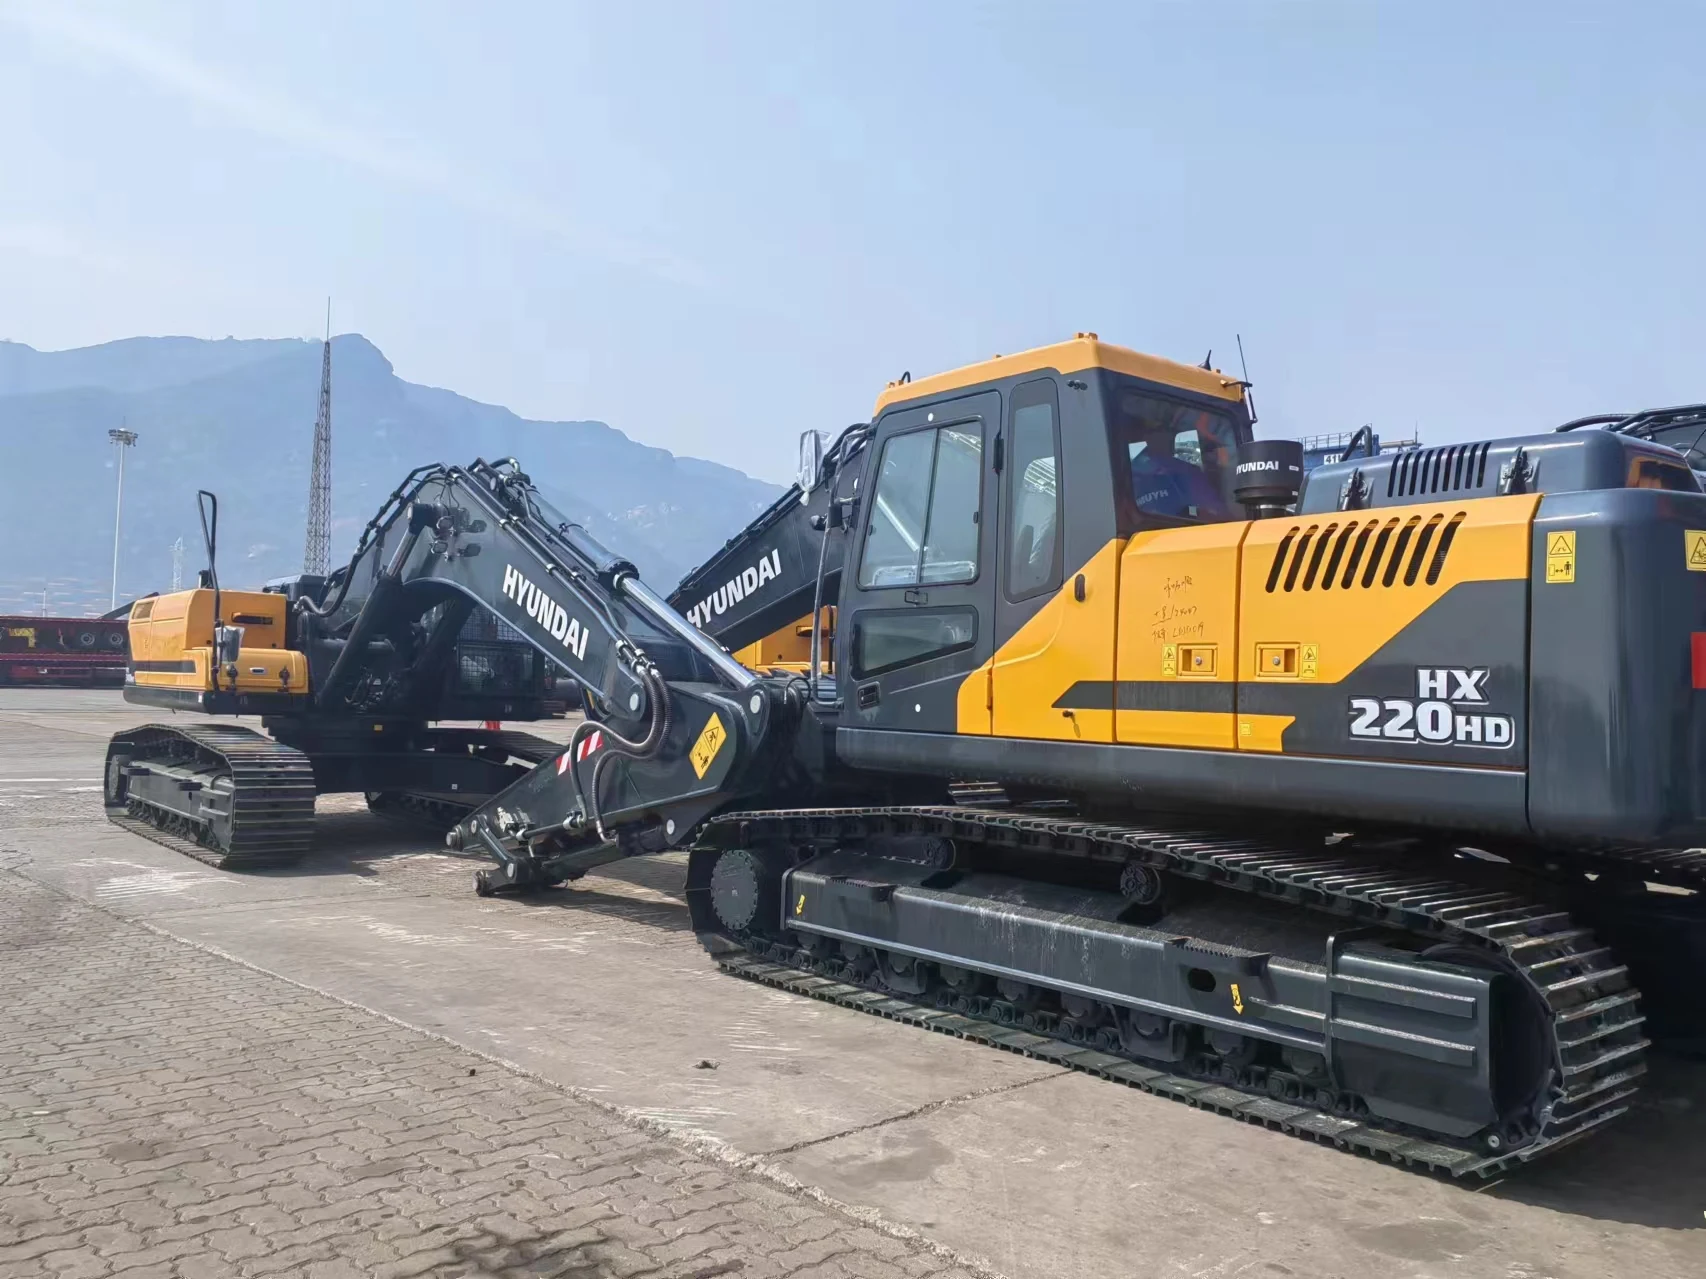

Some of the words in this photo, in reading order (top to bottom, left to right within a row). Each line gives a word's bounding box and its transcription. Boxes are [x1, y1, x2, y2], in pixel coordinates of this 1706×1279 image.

[502, 563, 590, 661] HYUNDAI
[686, 548, 782, 629] HYUNDAI
[1417, 669, 1487, 700] HX
[1350, 698, 1511, 744] 220HD
